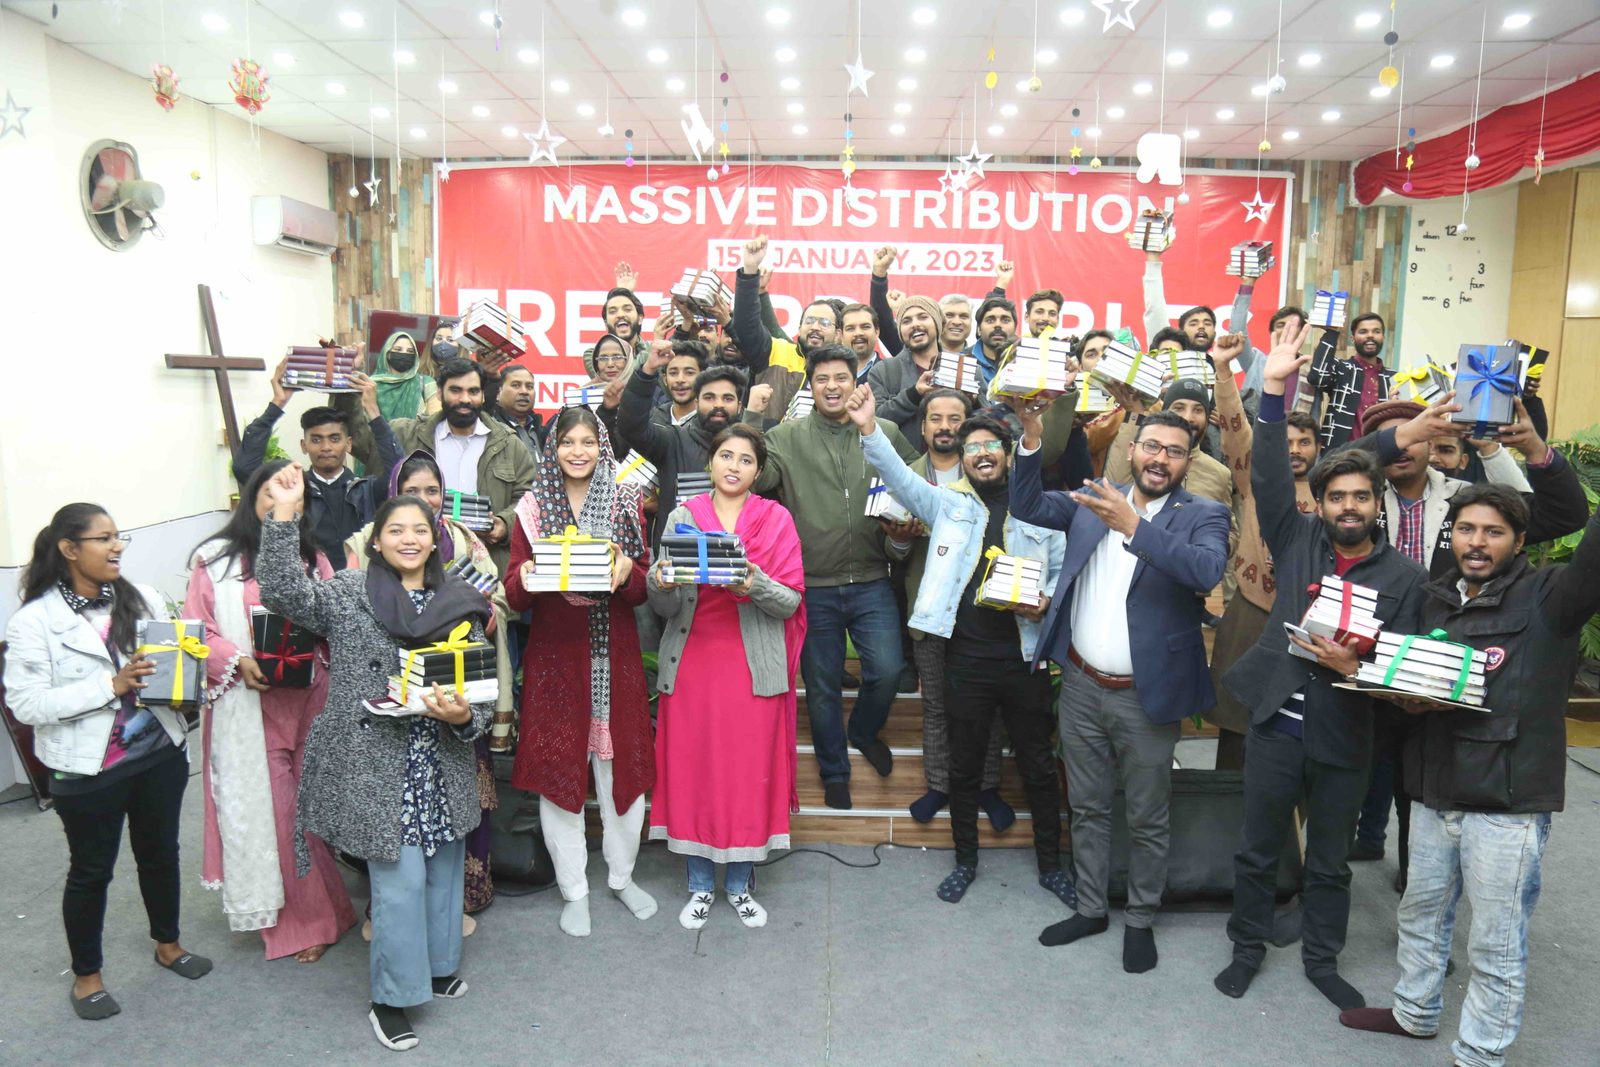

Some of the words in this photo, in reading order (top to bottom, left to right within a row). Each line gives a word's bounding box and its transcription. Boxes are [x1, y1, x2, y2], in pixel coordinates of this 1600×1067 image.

[544, 185, 777, 225] MASSIVE
[791, 187, 1175, 234] DISTRIBUTION
[1445, 225, 1457, 236] 12
[772, 247, 917, 273] JANUAY,
[926, 249, 996, 272] 2023
[1410, 262, 1418, 273] 9
[1478, 263, 1485, 274] 3
[1443, 298, 1451, 309] 6
[458, 288, 664, 358] RE
